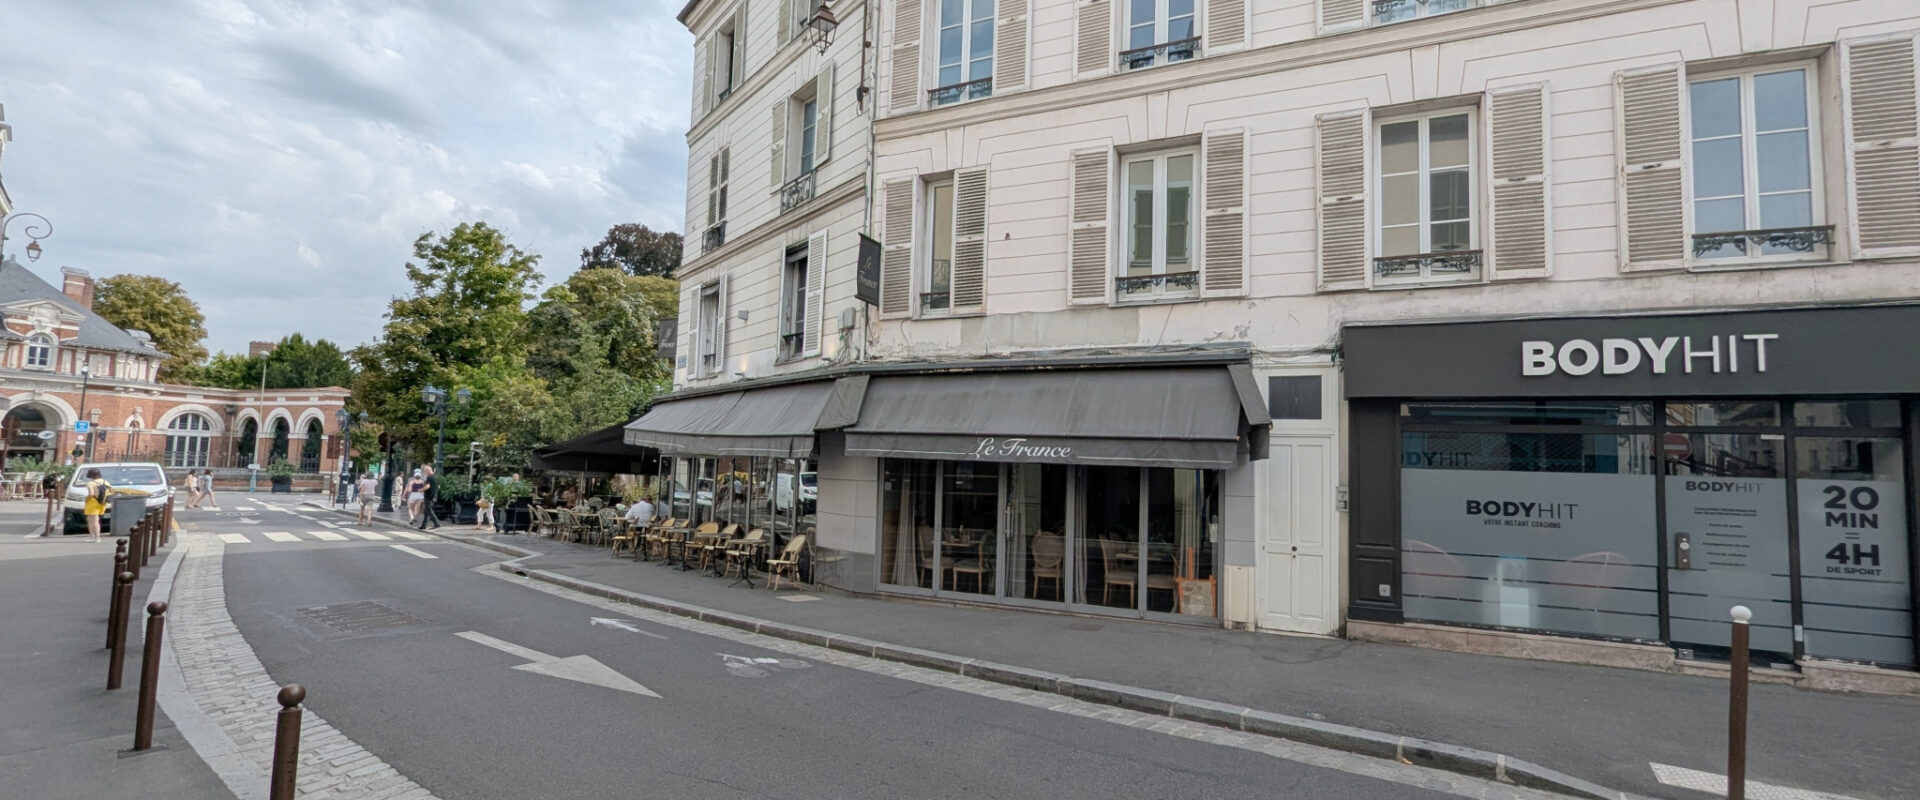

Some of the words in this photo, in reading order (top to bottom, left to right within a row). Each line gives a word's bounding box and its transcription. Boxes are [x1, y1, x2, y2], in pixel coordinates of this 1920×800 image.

[863, 255, 873, 272] Le
[1522, 334, 1779, 376] BODYHIT
[975, 437, 996, 459] Le
[999, 438, 1073, 458] France
[1686, 481, 1763, 493] BODYHIT
[1823, 485, 1879, 511] 20
[1466, 500, 1579, 519] BODYHIT
[1504, 519, 1529, 527] INSTANT
[1825, 511, 1879, 529] MIN
[1825, 542, 1880, 566] 4H
[1826, 566, 1842, 574] DE
[1844, 567, 1882, 576] SPORT
